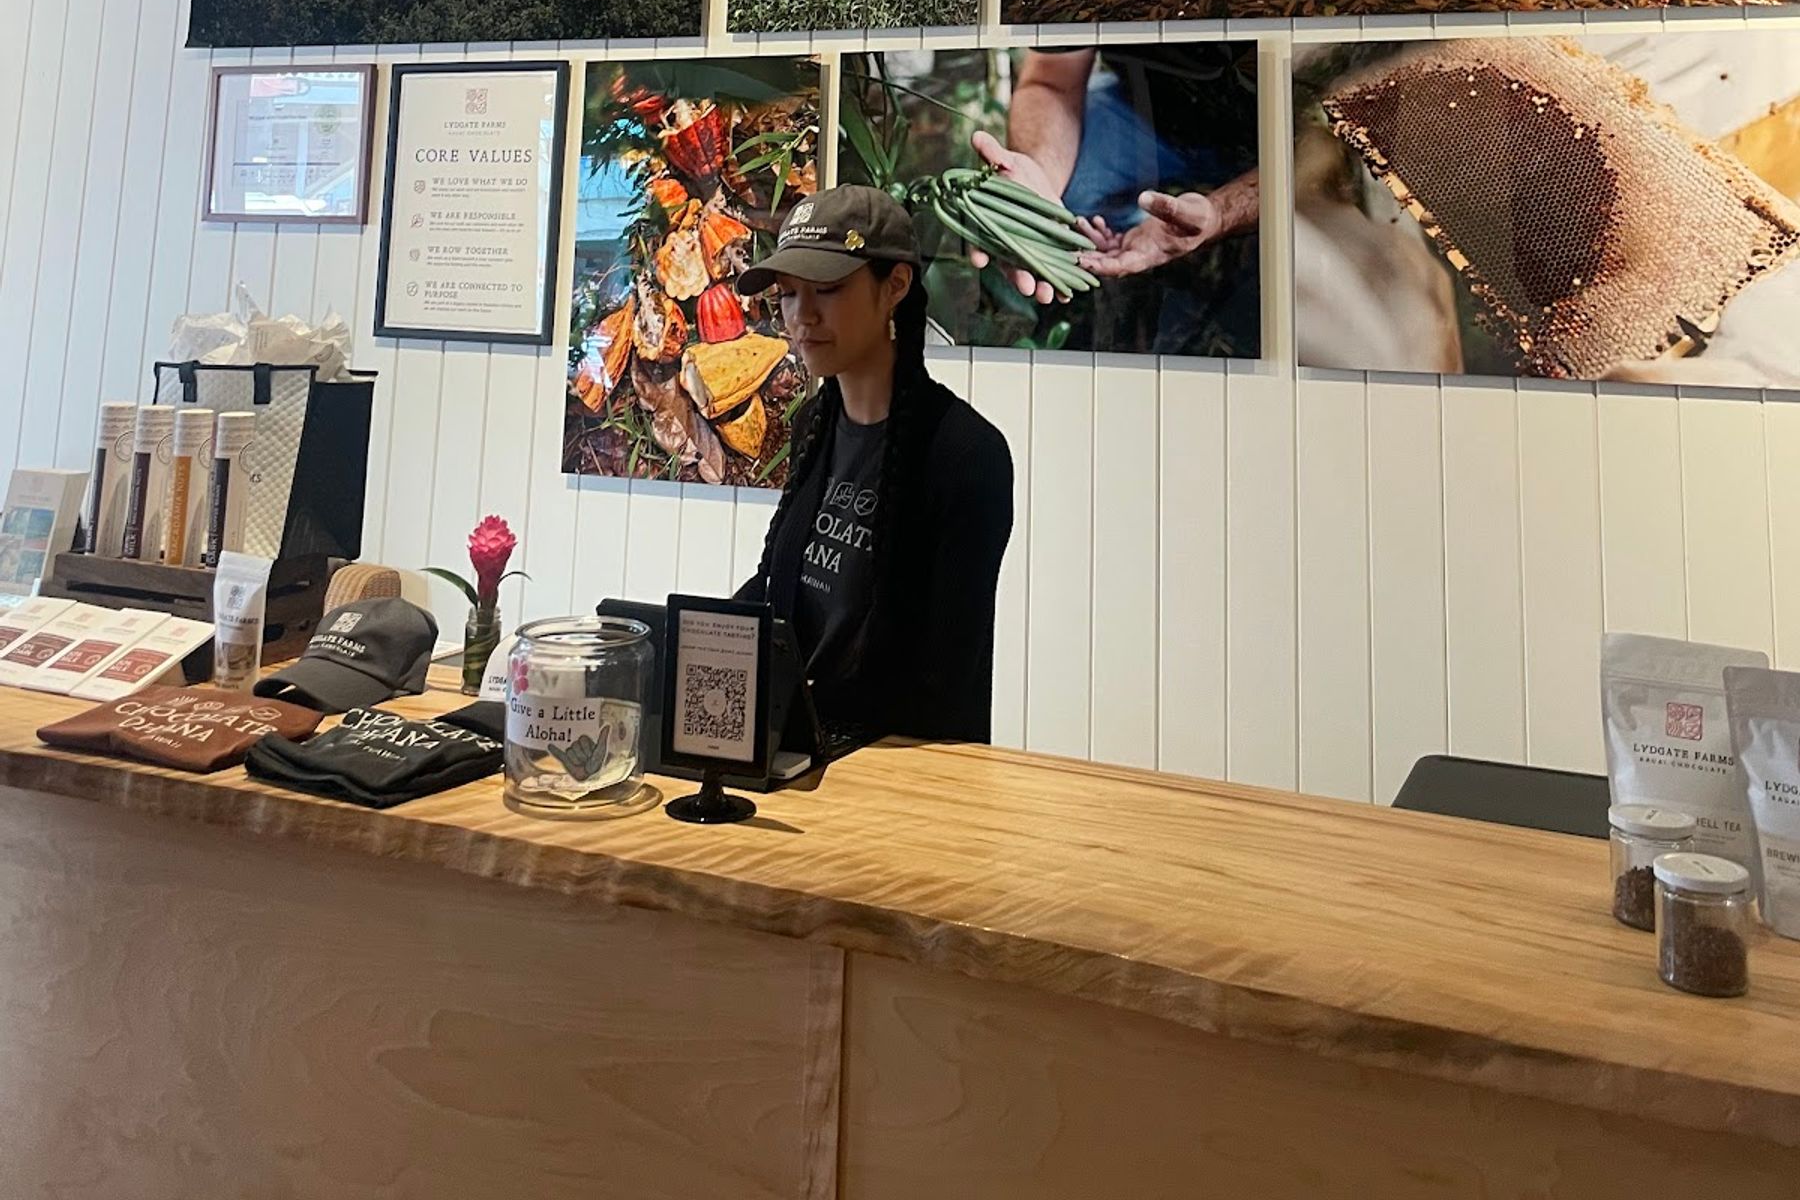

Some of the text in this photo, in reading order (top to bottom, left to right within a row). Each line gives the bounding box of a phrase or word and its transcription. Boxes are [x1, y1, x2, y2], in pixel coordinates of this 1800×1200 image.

[443, 121, 507, 129] LYDGATE FARMS
[415, 148, 533, 163] CORE VALUES
[432, 177, 528, 186] WE LOVE WHAT WE DO
[430, 211, 517, 220] WE ARE RESPONSIBLE
[427, 246, 509, 256] WE ROW TOGETHER
[425, 281, 523, 292] WE ARE CONNECTED TO
[424, 291, 459, 299] PURPOSE
[170, 495, 184, 558] MACADAMIA
[510, 697, 596, 721] Give a Little
[525, 724, 572, 742] Aloha!
[1633, 742, 1735, 767] LYDGATE FARMS
[1639, 756, 1727, 775] KAUAI CHOCOLATE
[1765, 779, 1800, 795] LYDG
[1724, 821, 1742, 833] TEA
